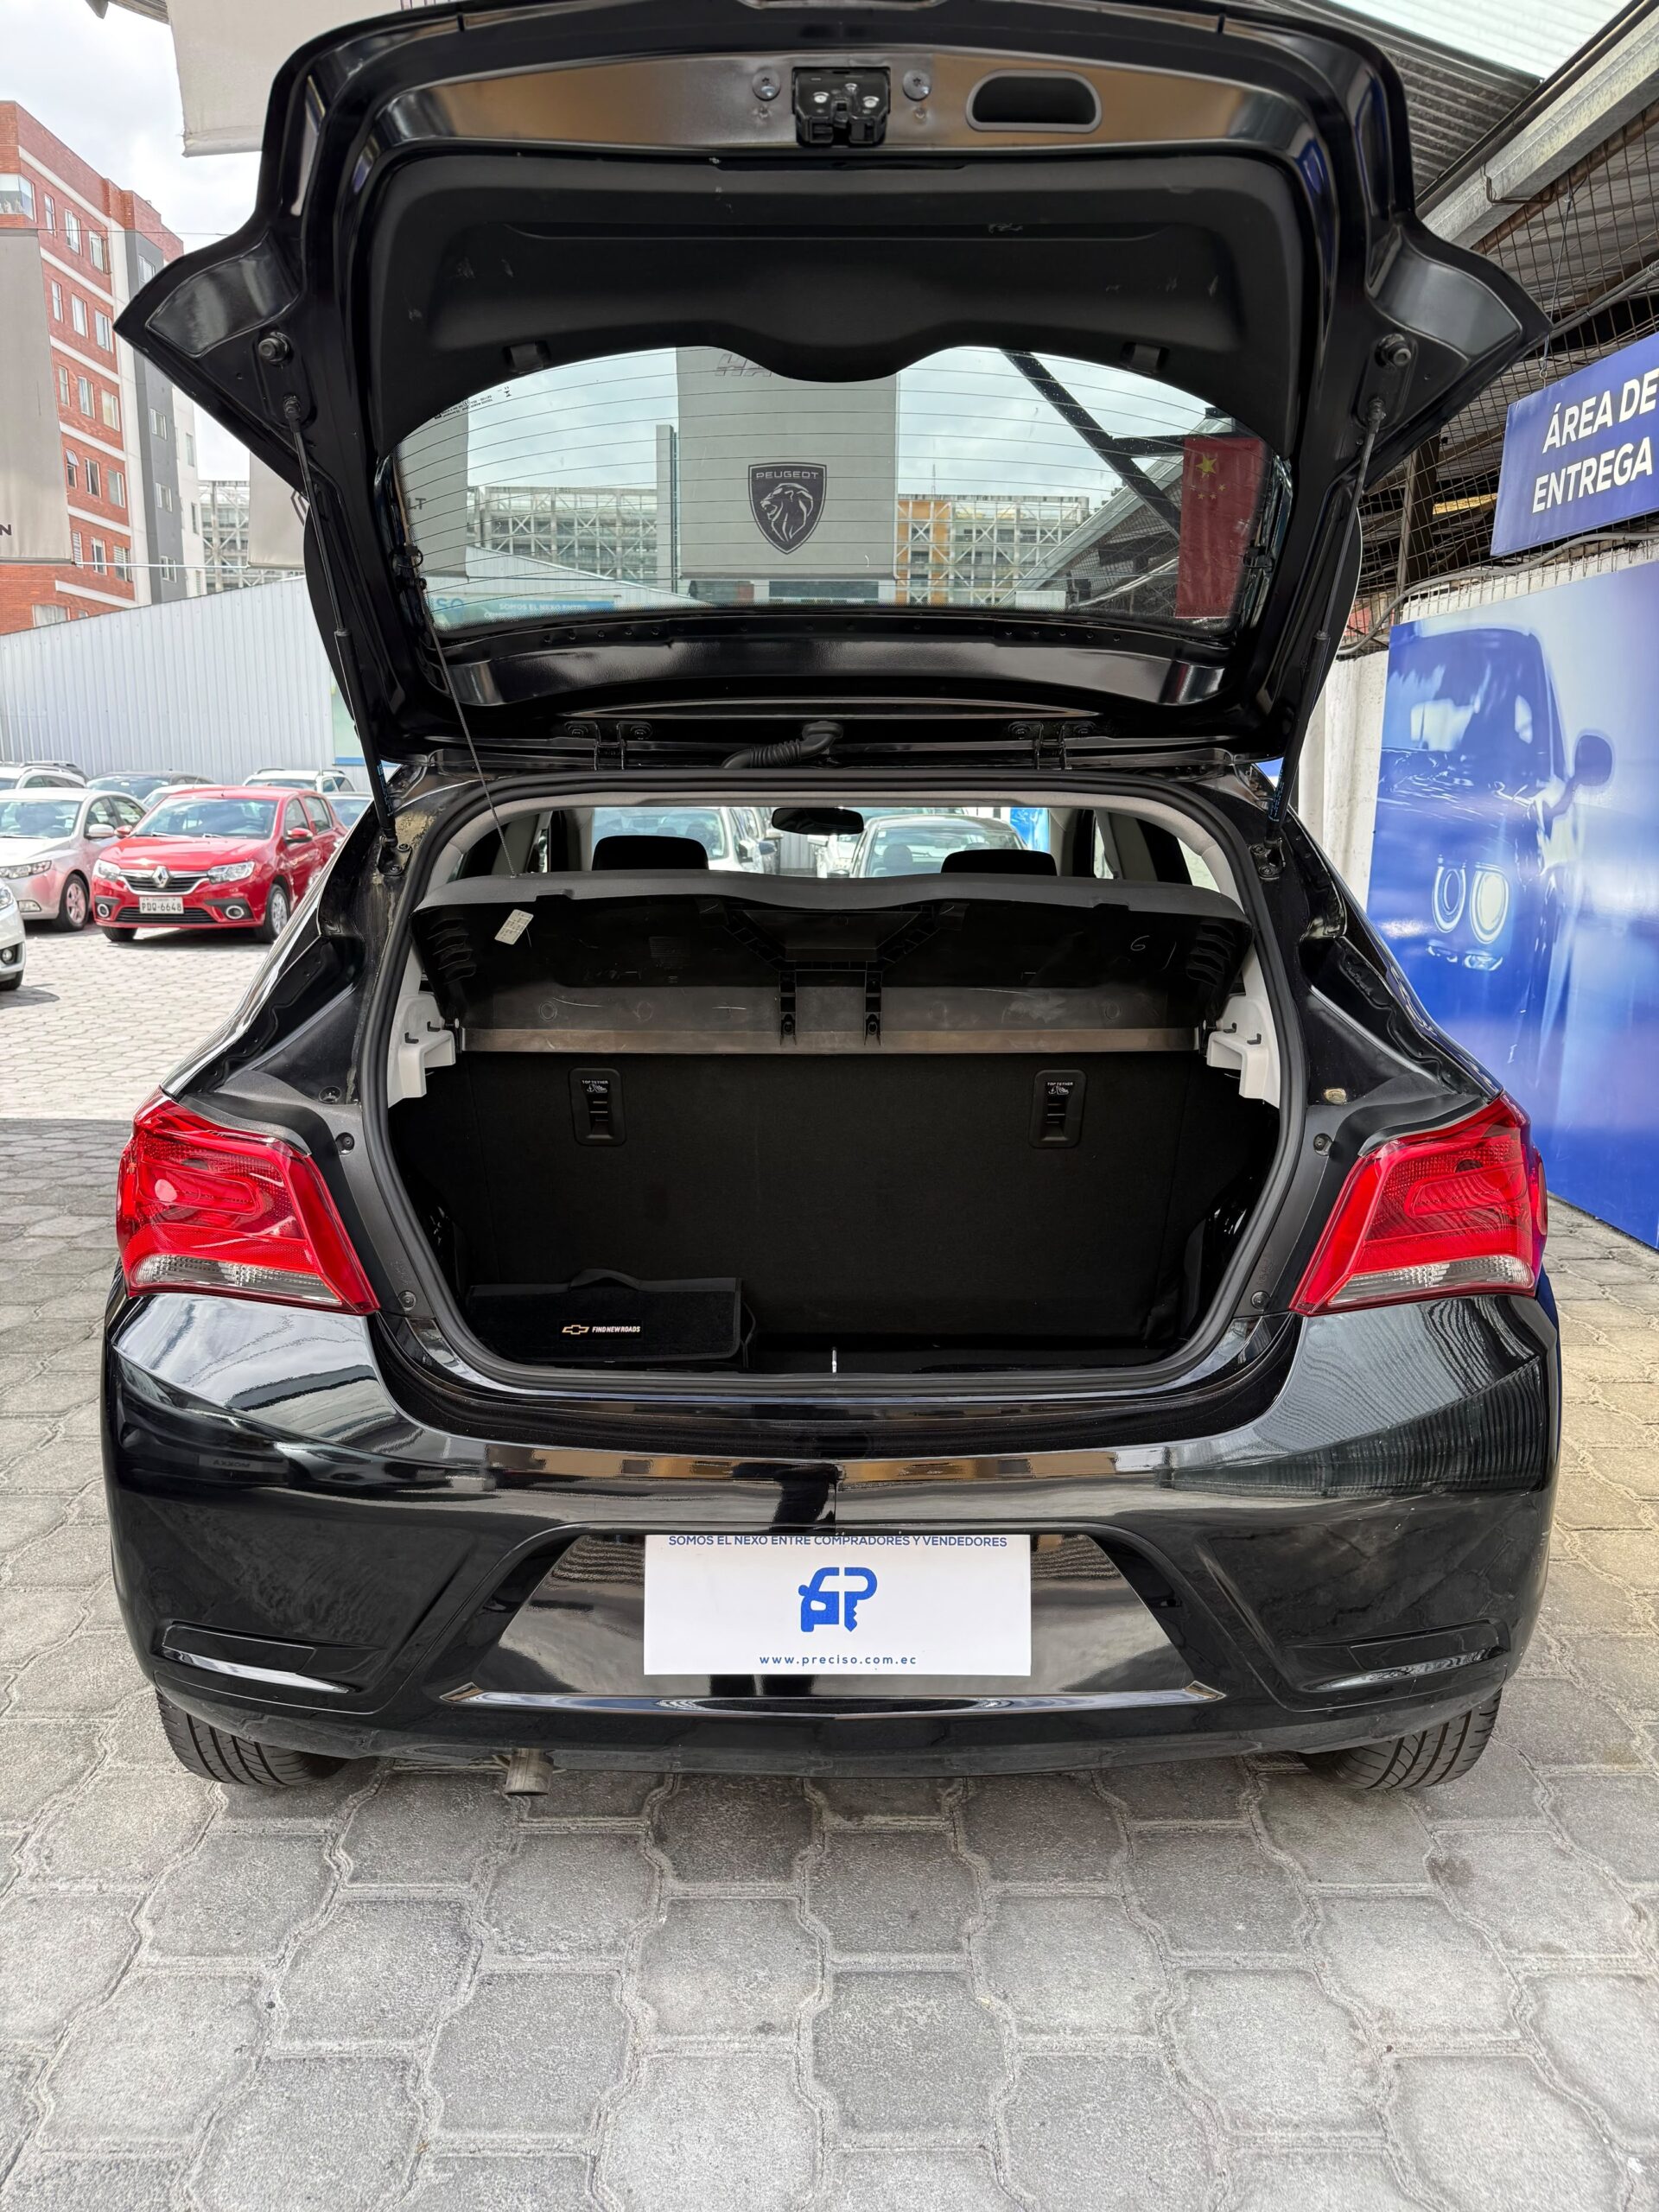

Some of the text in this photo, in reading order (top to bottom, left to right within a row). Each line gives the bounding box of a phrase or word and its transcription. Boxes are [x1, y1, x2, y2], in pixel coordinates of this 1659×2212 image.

[1542, 367, 1659, 454] ÁREA DE
[756, 471, 819, 480] PEUGEOT
[1532, 436, 1653, 513] ENTREGA
[669, 1535, 1007, 1547] SOMOS EL NEXO ENTRE COMPRADORES Y VENDEDORES
[760, 1655, 917, 1666] www.preciso.com.ec
